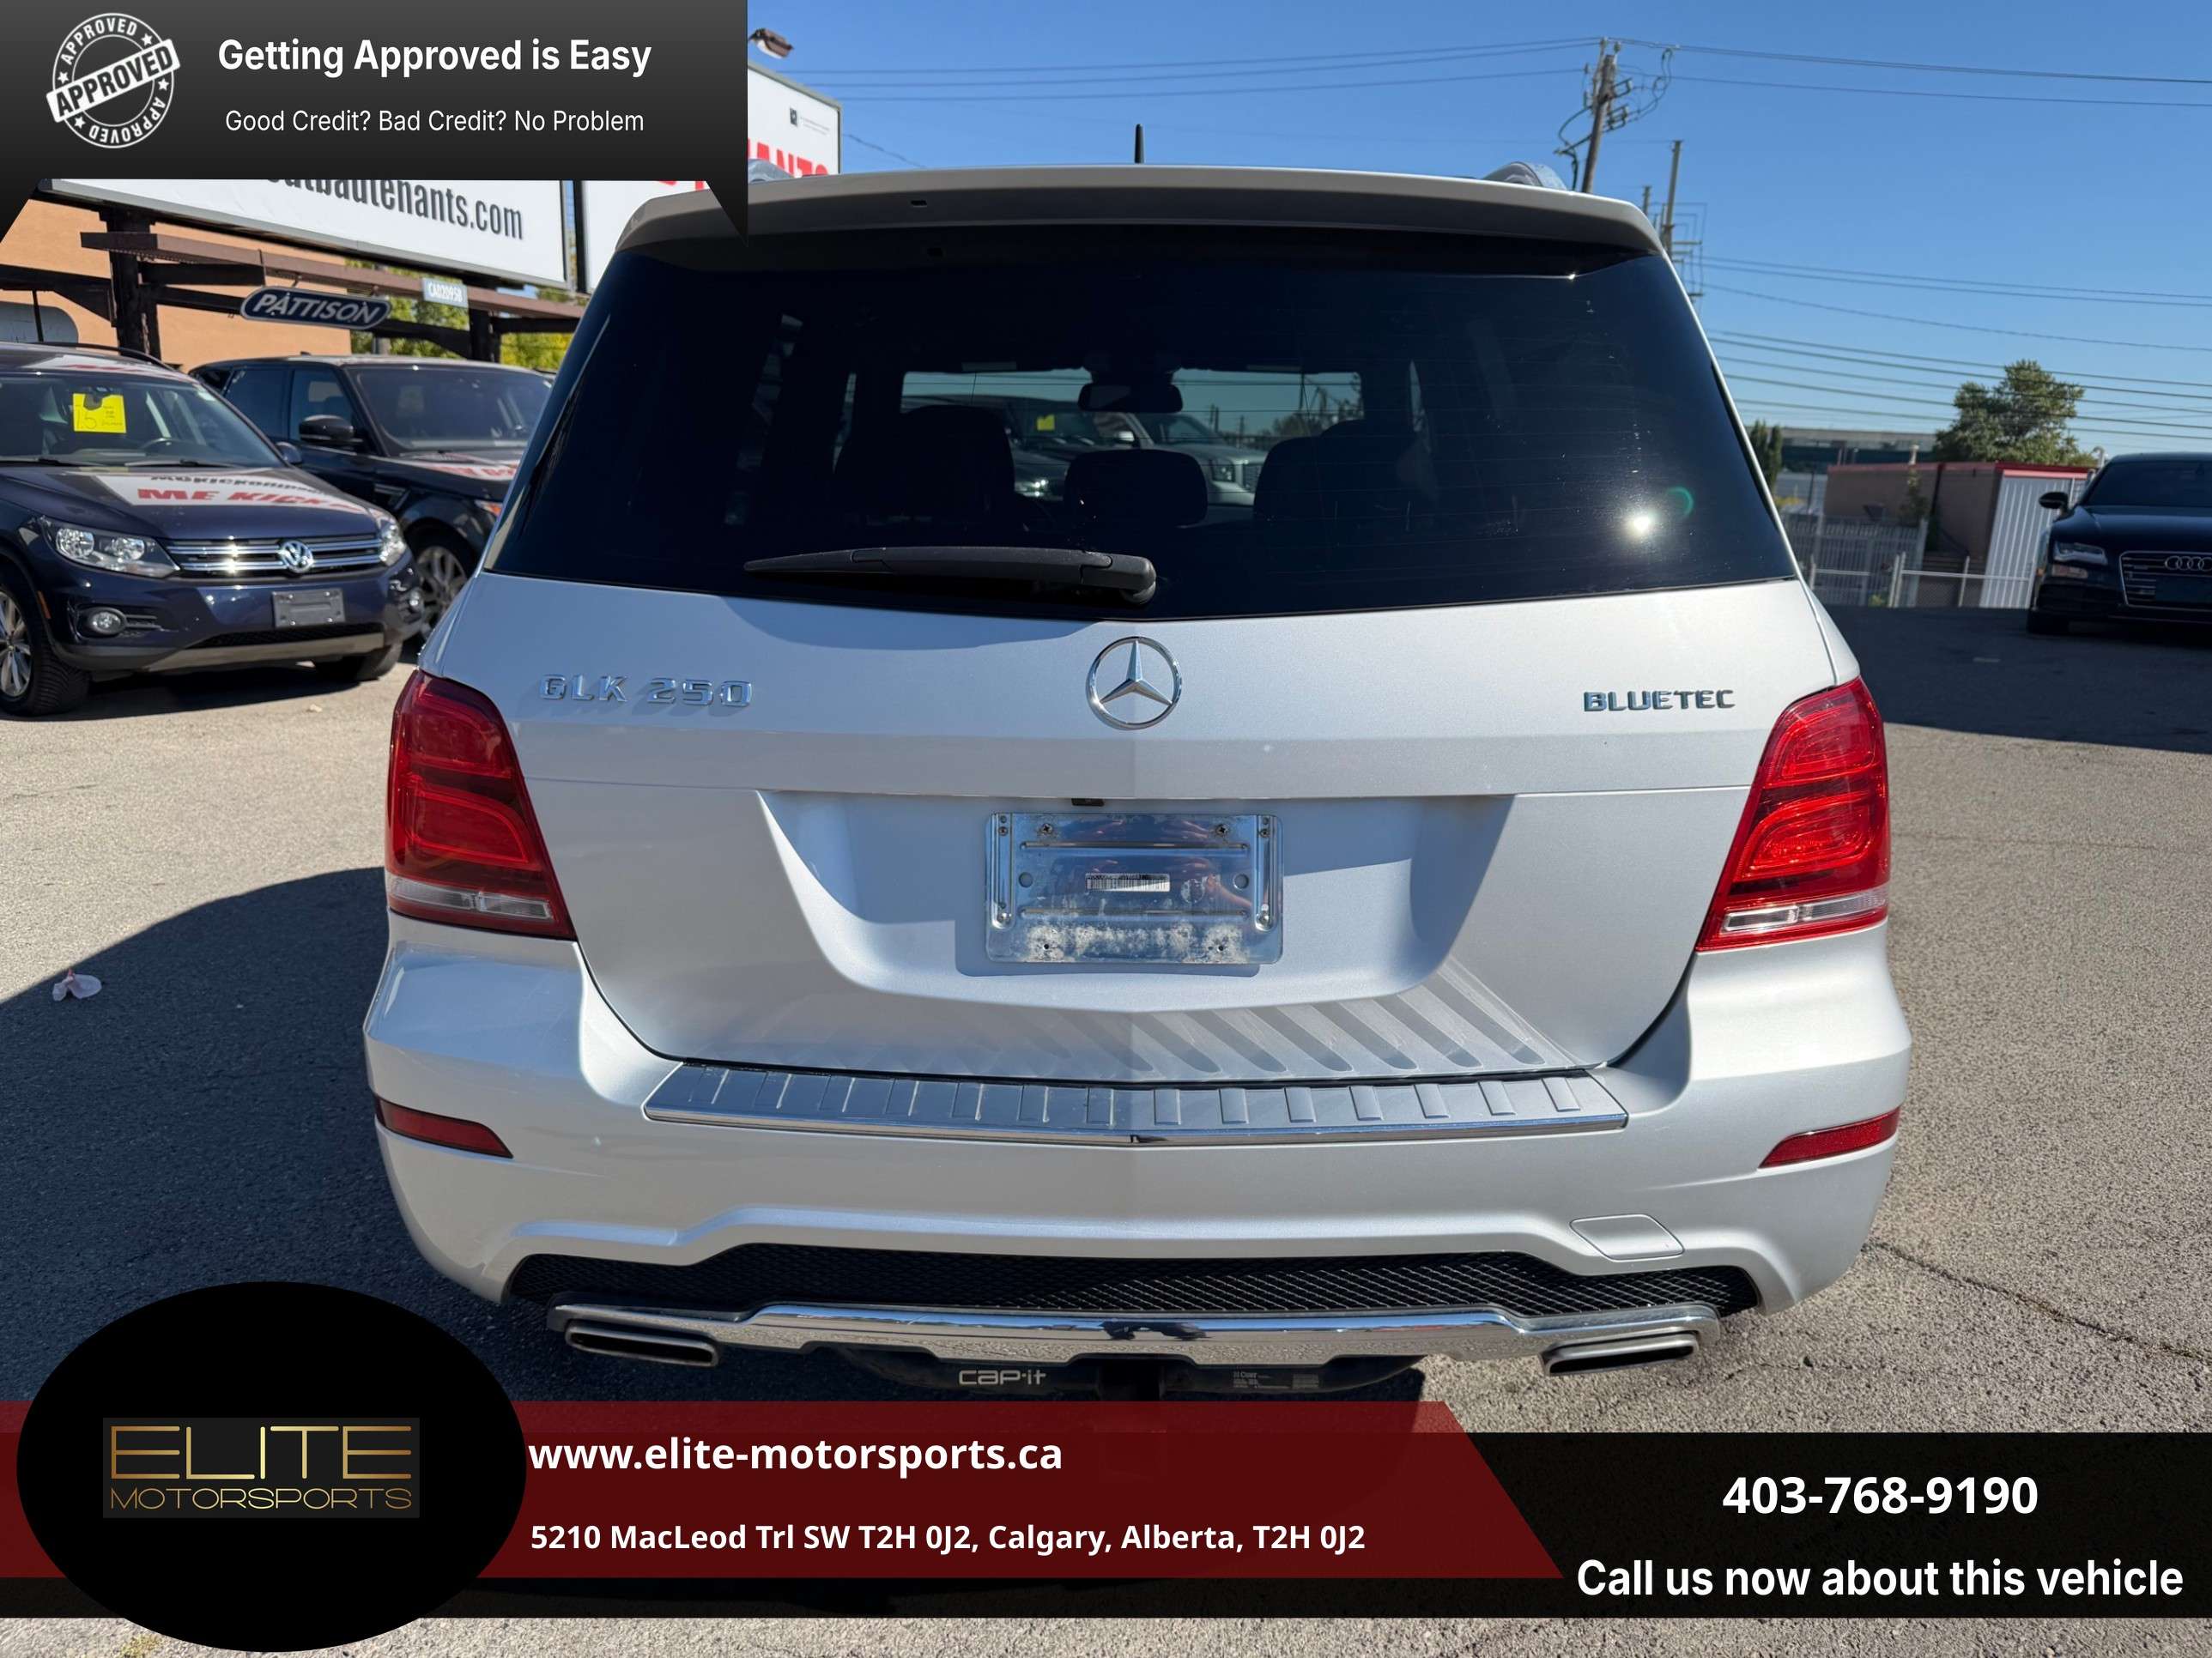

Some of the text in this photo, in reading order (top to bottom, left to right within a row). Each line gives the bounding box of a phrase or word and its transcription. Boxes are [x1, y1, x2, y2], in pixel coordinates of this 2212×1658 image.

[252, 293, 379, 324] PATTISON
[539, 674, 753, 707] GLK 250
[1583, 689, 1736, 712] BLUETEC
